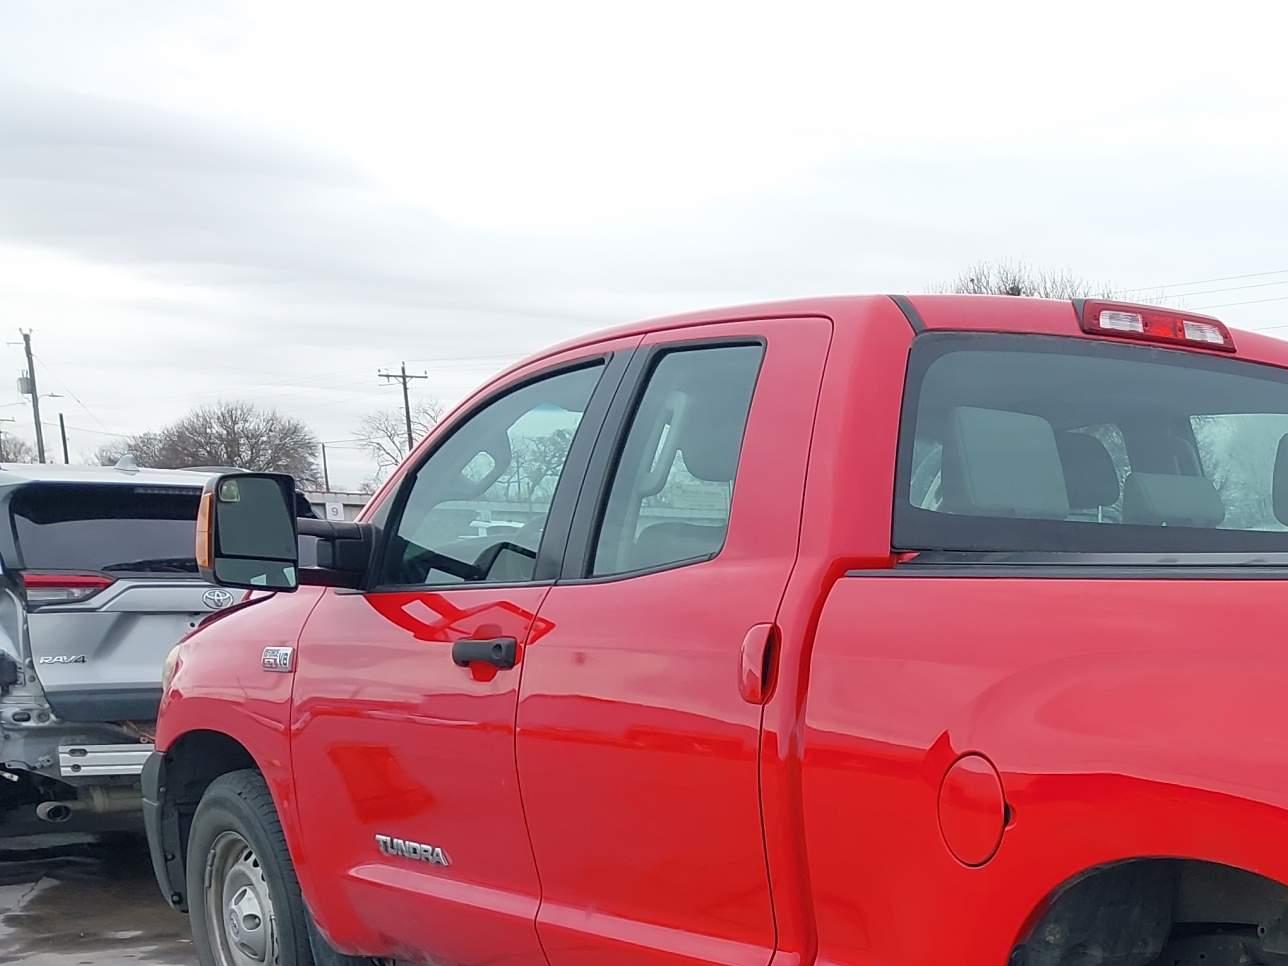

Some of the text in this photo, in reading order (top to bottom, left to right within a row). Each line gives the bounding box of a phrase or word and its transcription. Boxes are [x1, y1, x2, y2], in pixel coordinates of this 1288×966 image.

[331, 507, 339, 517] 9
[40, 655, 87, 664] RAV4
[375, 834, 449, 866] TUNDRA
